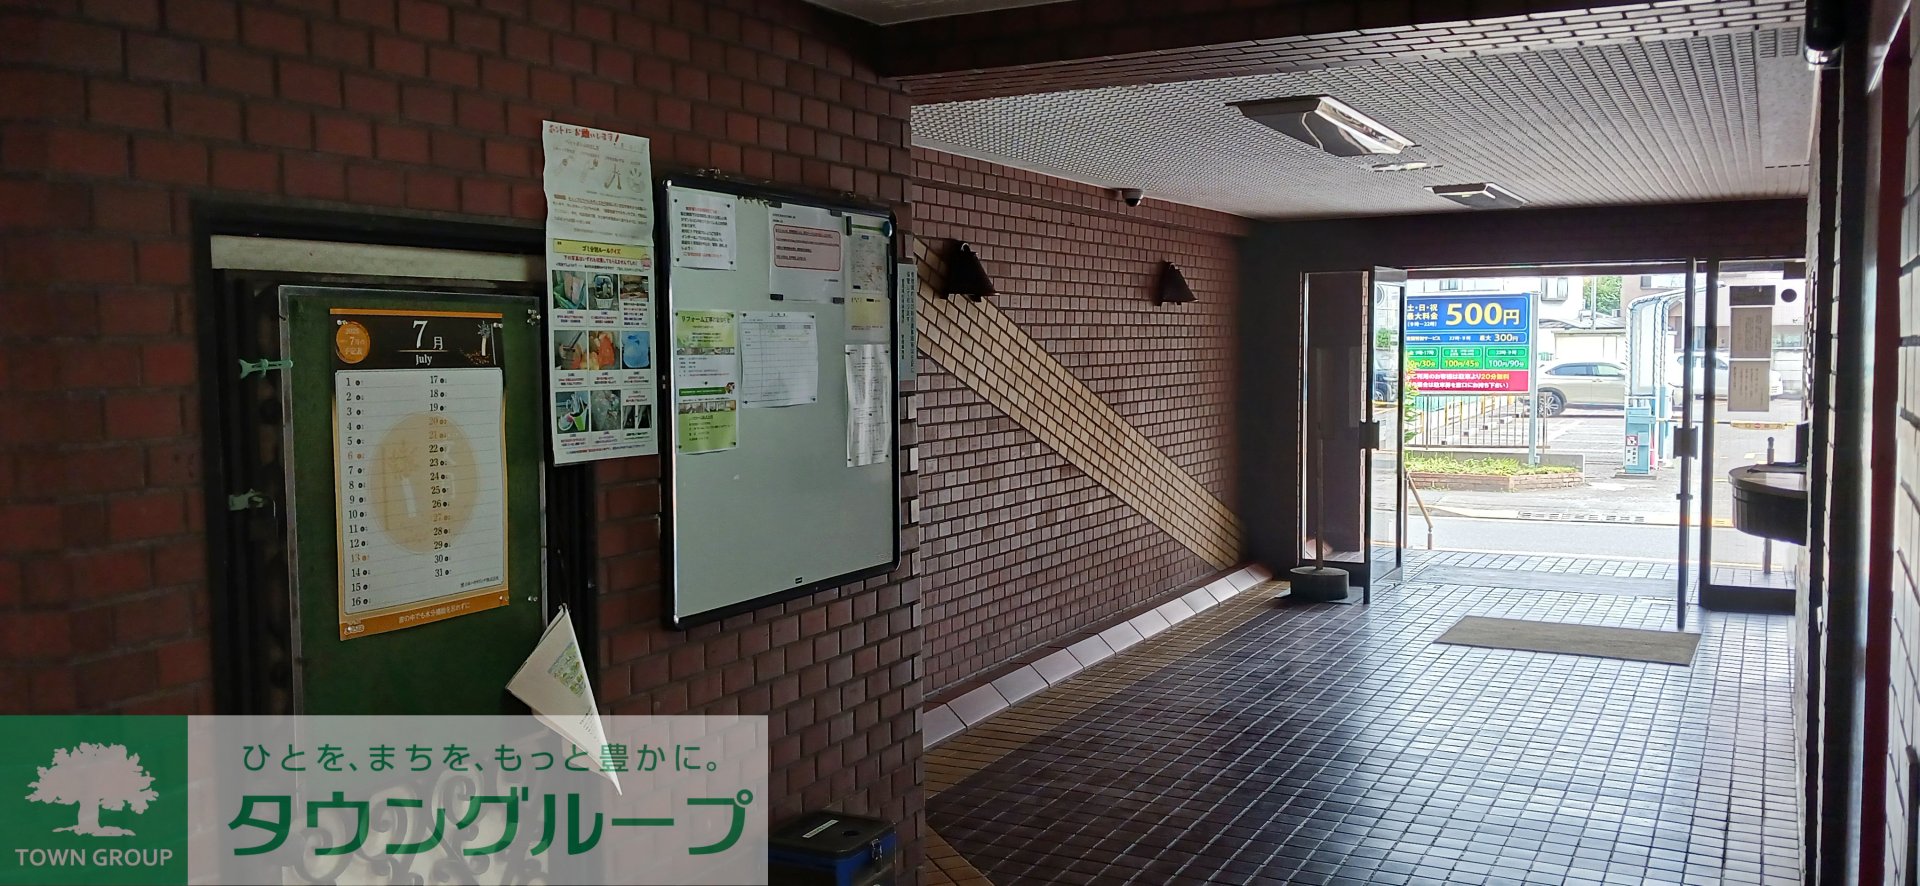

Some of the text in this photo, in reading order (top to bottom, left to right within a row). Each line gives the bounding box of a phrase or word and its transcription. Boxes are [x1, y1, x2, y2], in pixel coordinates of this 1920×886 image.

[1446, 303, 1520, 325] 500円
[412, 320, 443, 350] 7月
[1494, 334, 1518, 342] 300円
[416, 354, 432, 366] July
[346, 378, 350, 386] 1
[430, 376, 438, 384] 17
[346, 392, 352, 401] 2
[430, 403, 438, 411] 19
[429, 417, 438, 425] 20
[347, 422, 352, 430] 4
[429, 431, 438, 439] 21
[347, 437, 352, 445] 5
[429, 445, 438, 453] 22
[430, 459, 438, 467] 23
[349, 481, 354, 489] 8
[431, 486, 440, 494] 25
[350, 495, 354, 503] 9
[432, 500, 441, 508] 26
[349, 510, 357, 519] 10
[349, 525, 358, 533] 11
[350, 539, 359, 548] 12
[434, 541, 443, 549] 29
[351, 554, 360, 562] 13
[435, 555, 443, 563] 30
[352, 568, 360, 577] 14
[435, 569, 443, 577] 31
[352, 583, 360, 592] 15
[352, 598, 361, 606] 16
